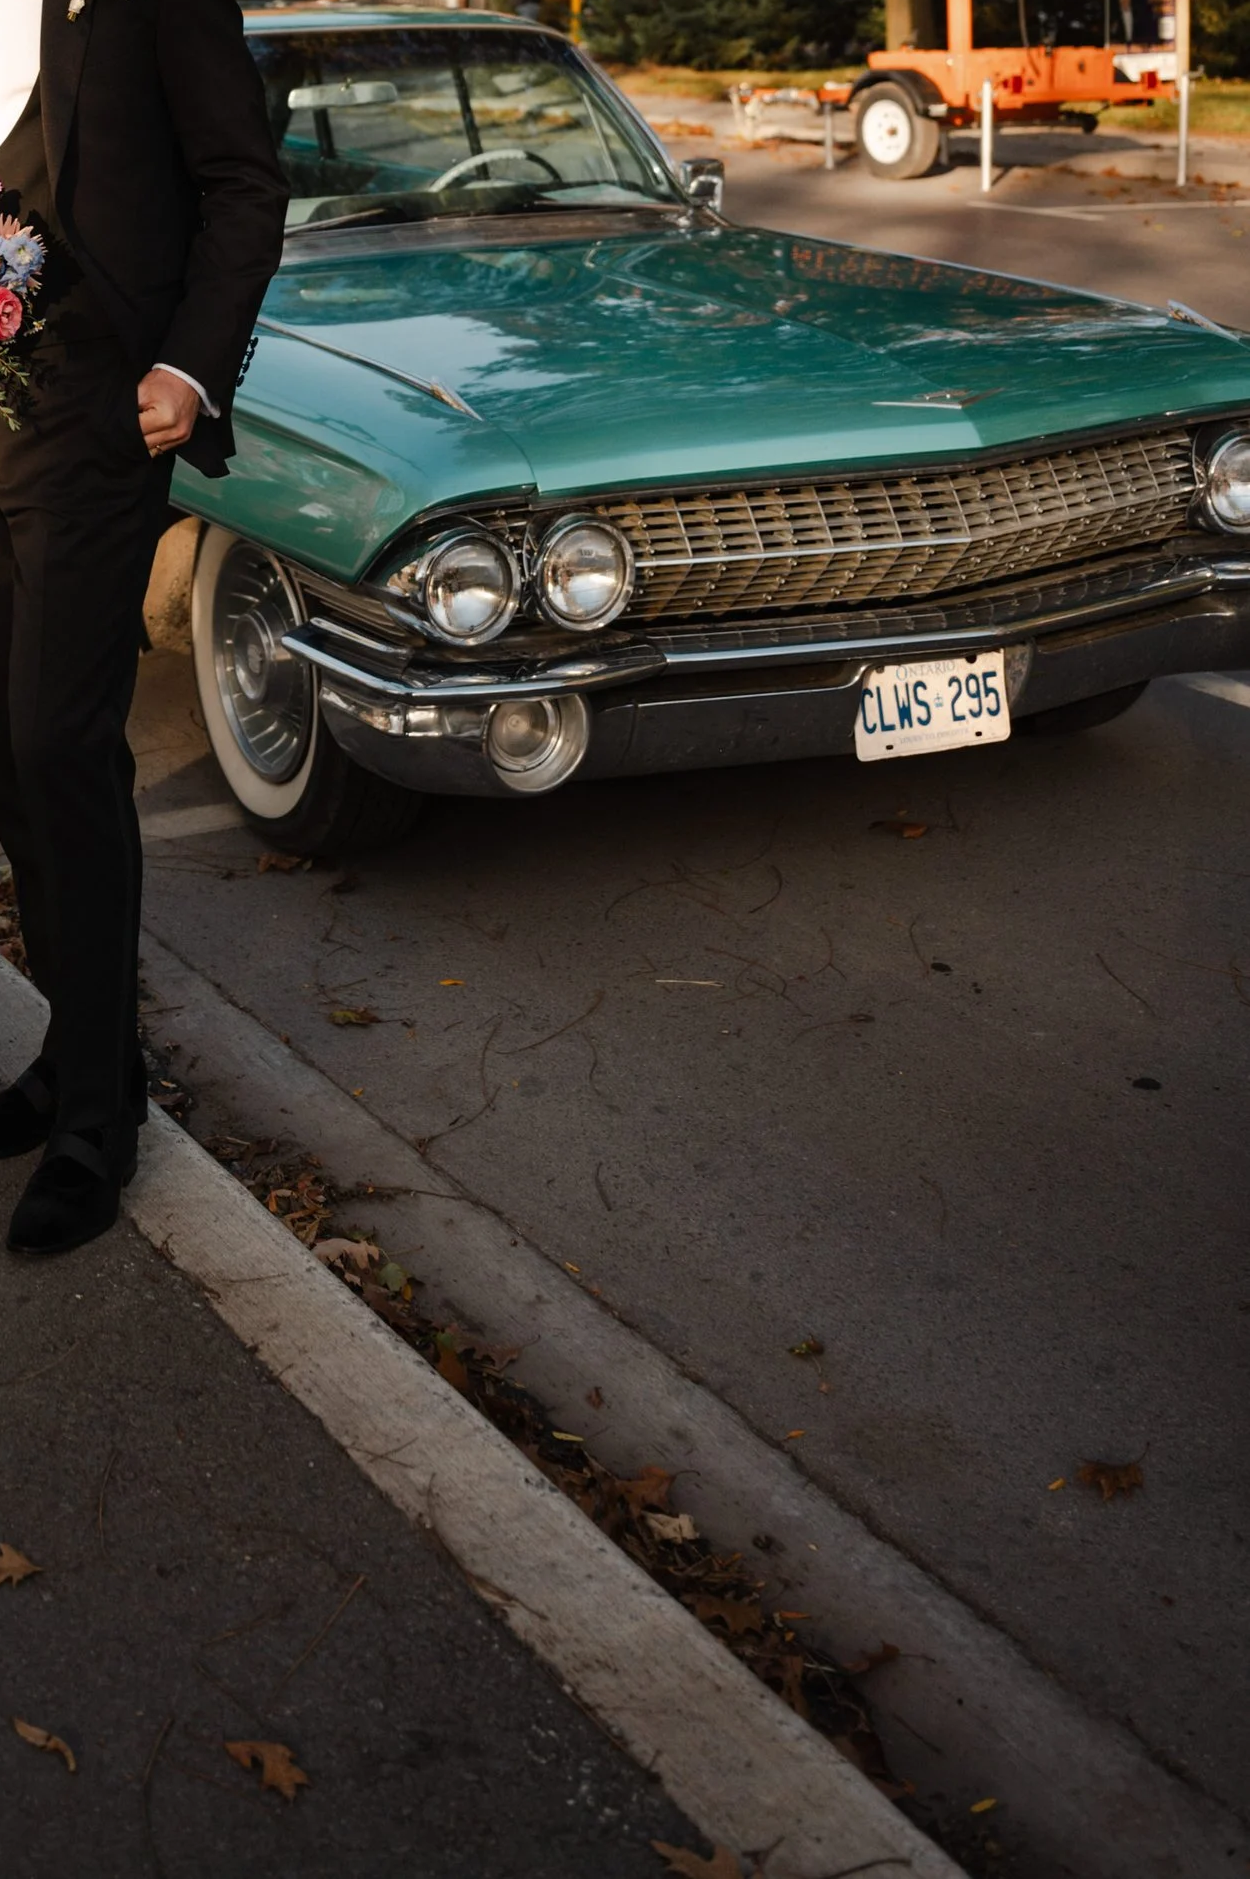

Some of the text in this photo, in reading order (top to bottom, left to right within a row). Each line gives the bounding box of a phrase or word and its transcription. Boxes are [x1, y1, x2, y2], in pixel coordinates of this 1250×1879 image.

[896, 660, 956, 682] ONTARIO
[861, 671, 1001, 734] CLWS 295
